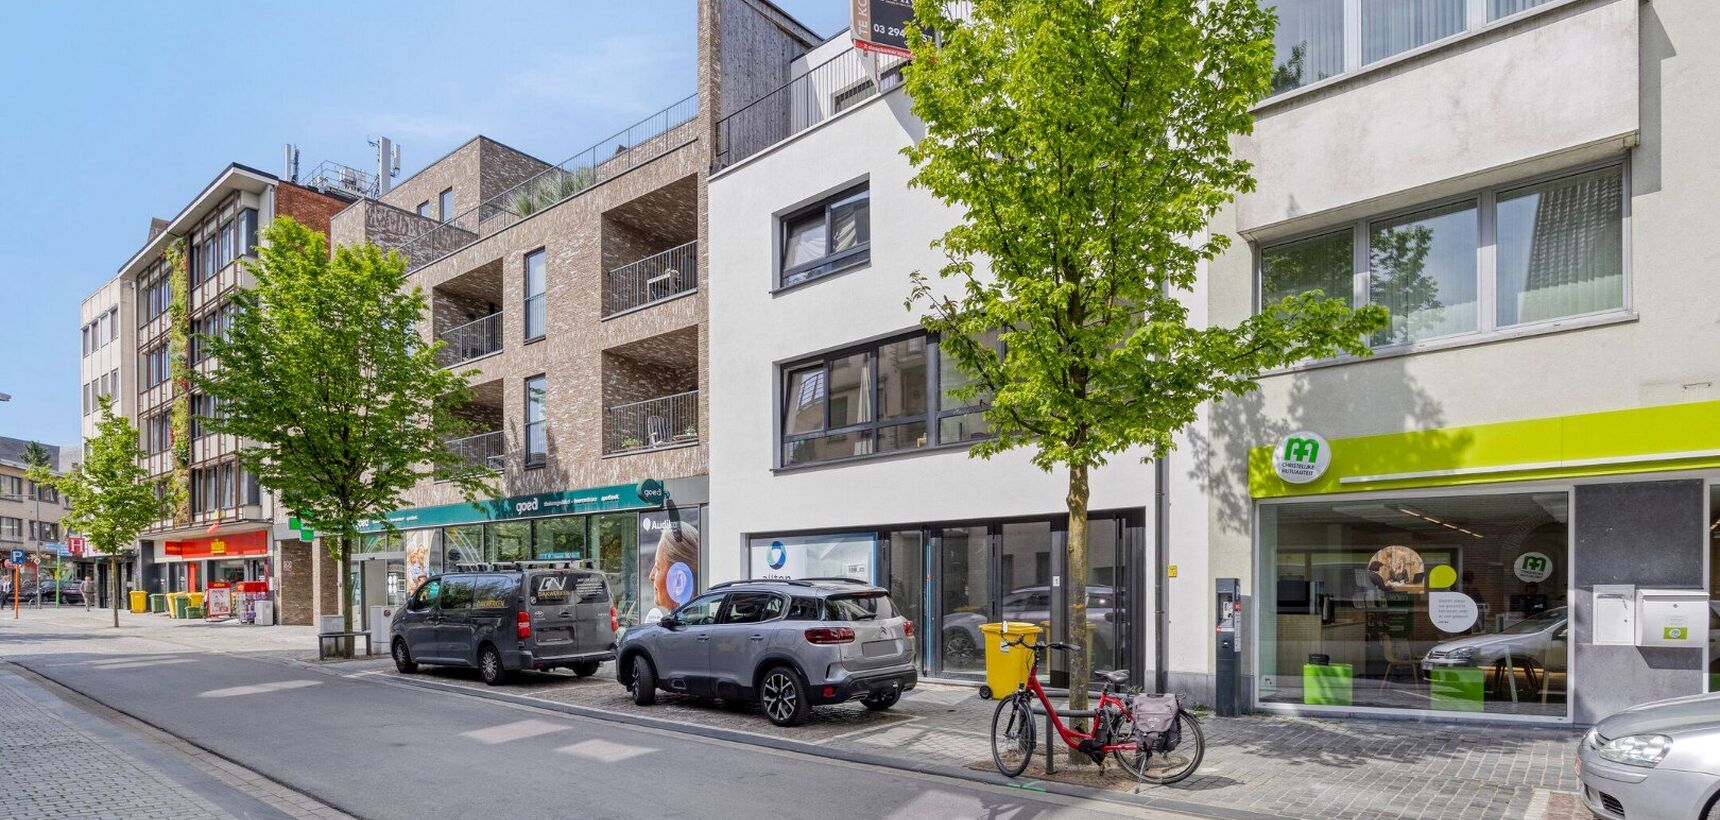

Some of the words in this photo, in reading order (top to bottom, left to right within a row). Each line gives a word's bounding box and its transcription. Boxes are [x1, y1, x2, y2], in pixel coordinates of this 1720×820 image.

[858, 21, 868, 34] TE
[873, 24, 885, 34] 03
[644, 488, 662, 497] goed
[516, 498, 538, 514] goed
[651, 520, 677, 530] Audika
[71, 540, 83, 552] H
[12, 551, 23, 562] P
